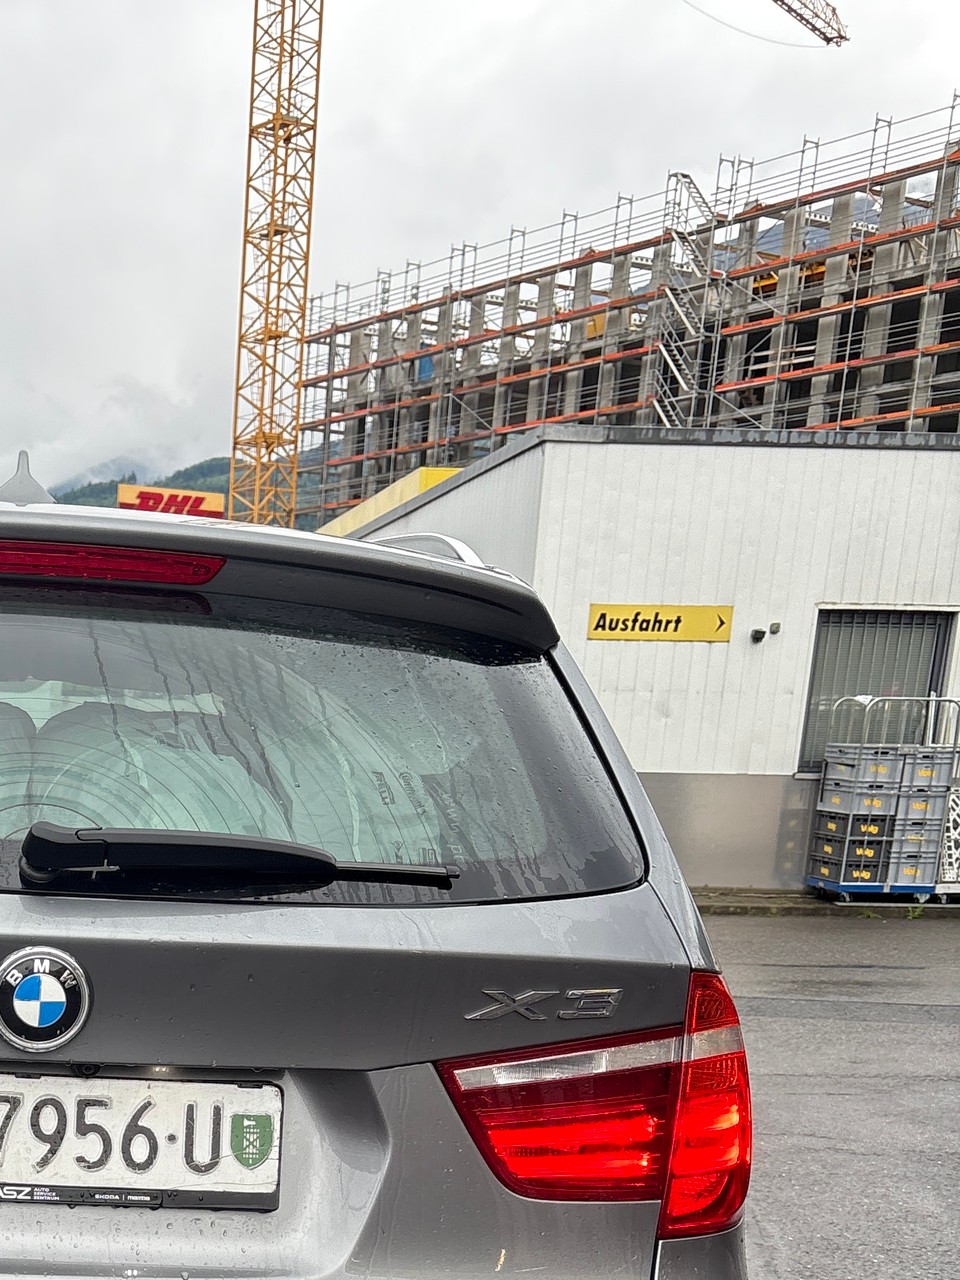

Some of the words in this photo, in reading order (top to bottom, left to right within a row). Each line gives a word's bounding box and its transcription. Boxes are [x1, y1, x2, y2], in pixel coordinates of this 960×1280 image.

[136, 491, 206, 514] DHL
[593, 612, 682, 632] Ausfahrt
[5, 958, 77, 989] BMW
[463, 988, 624, 1020] X3
